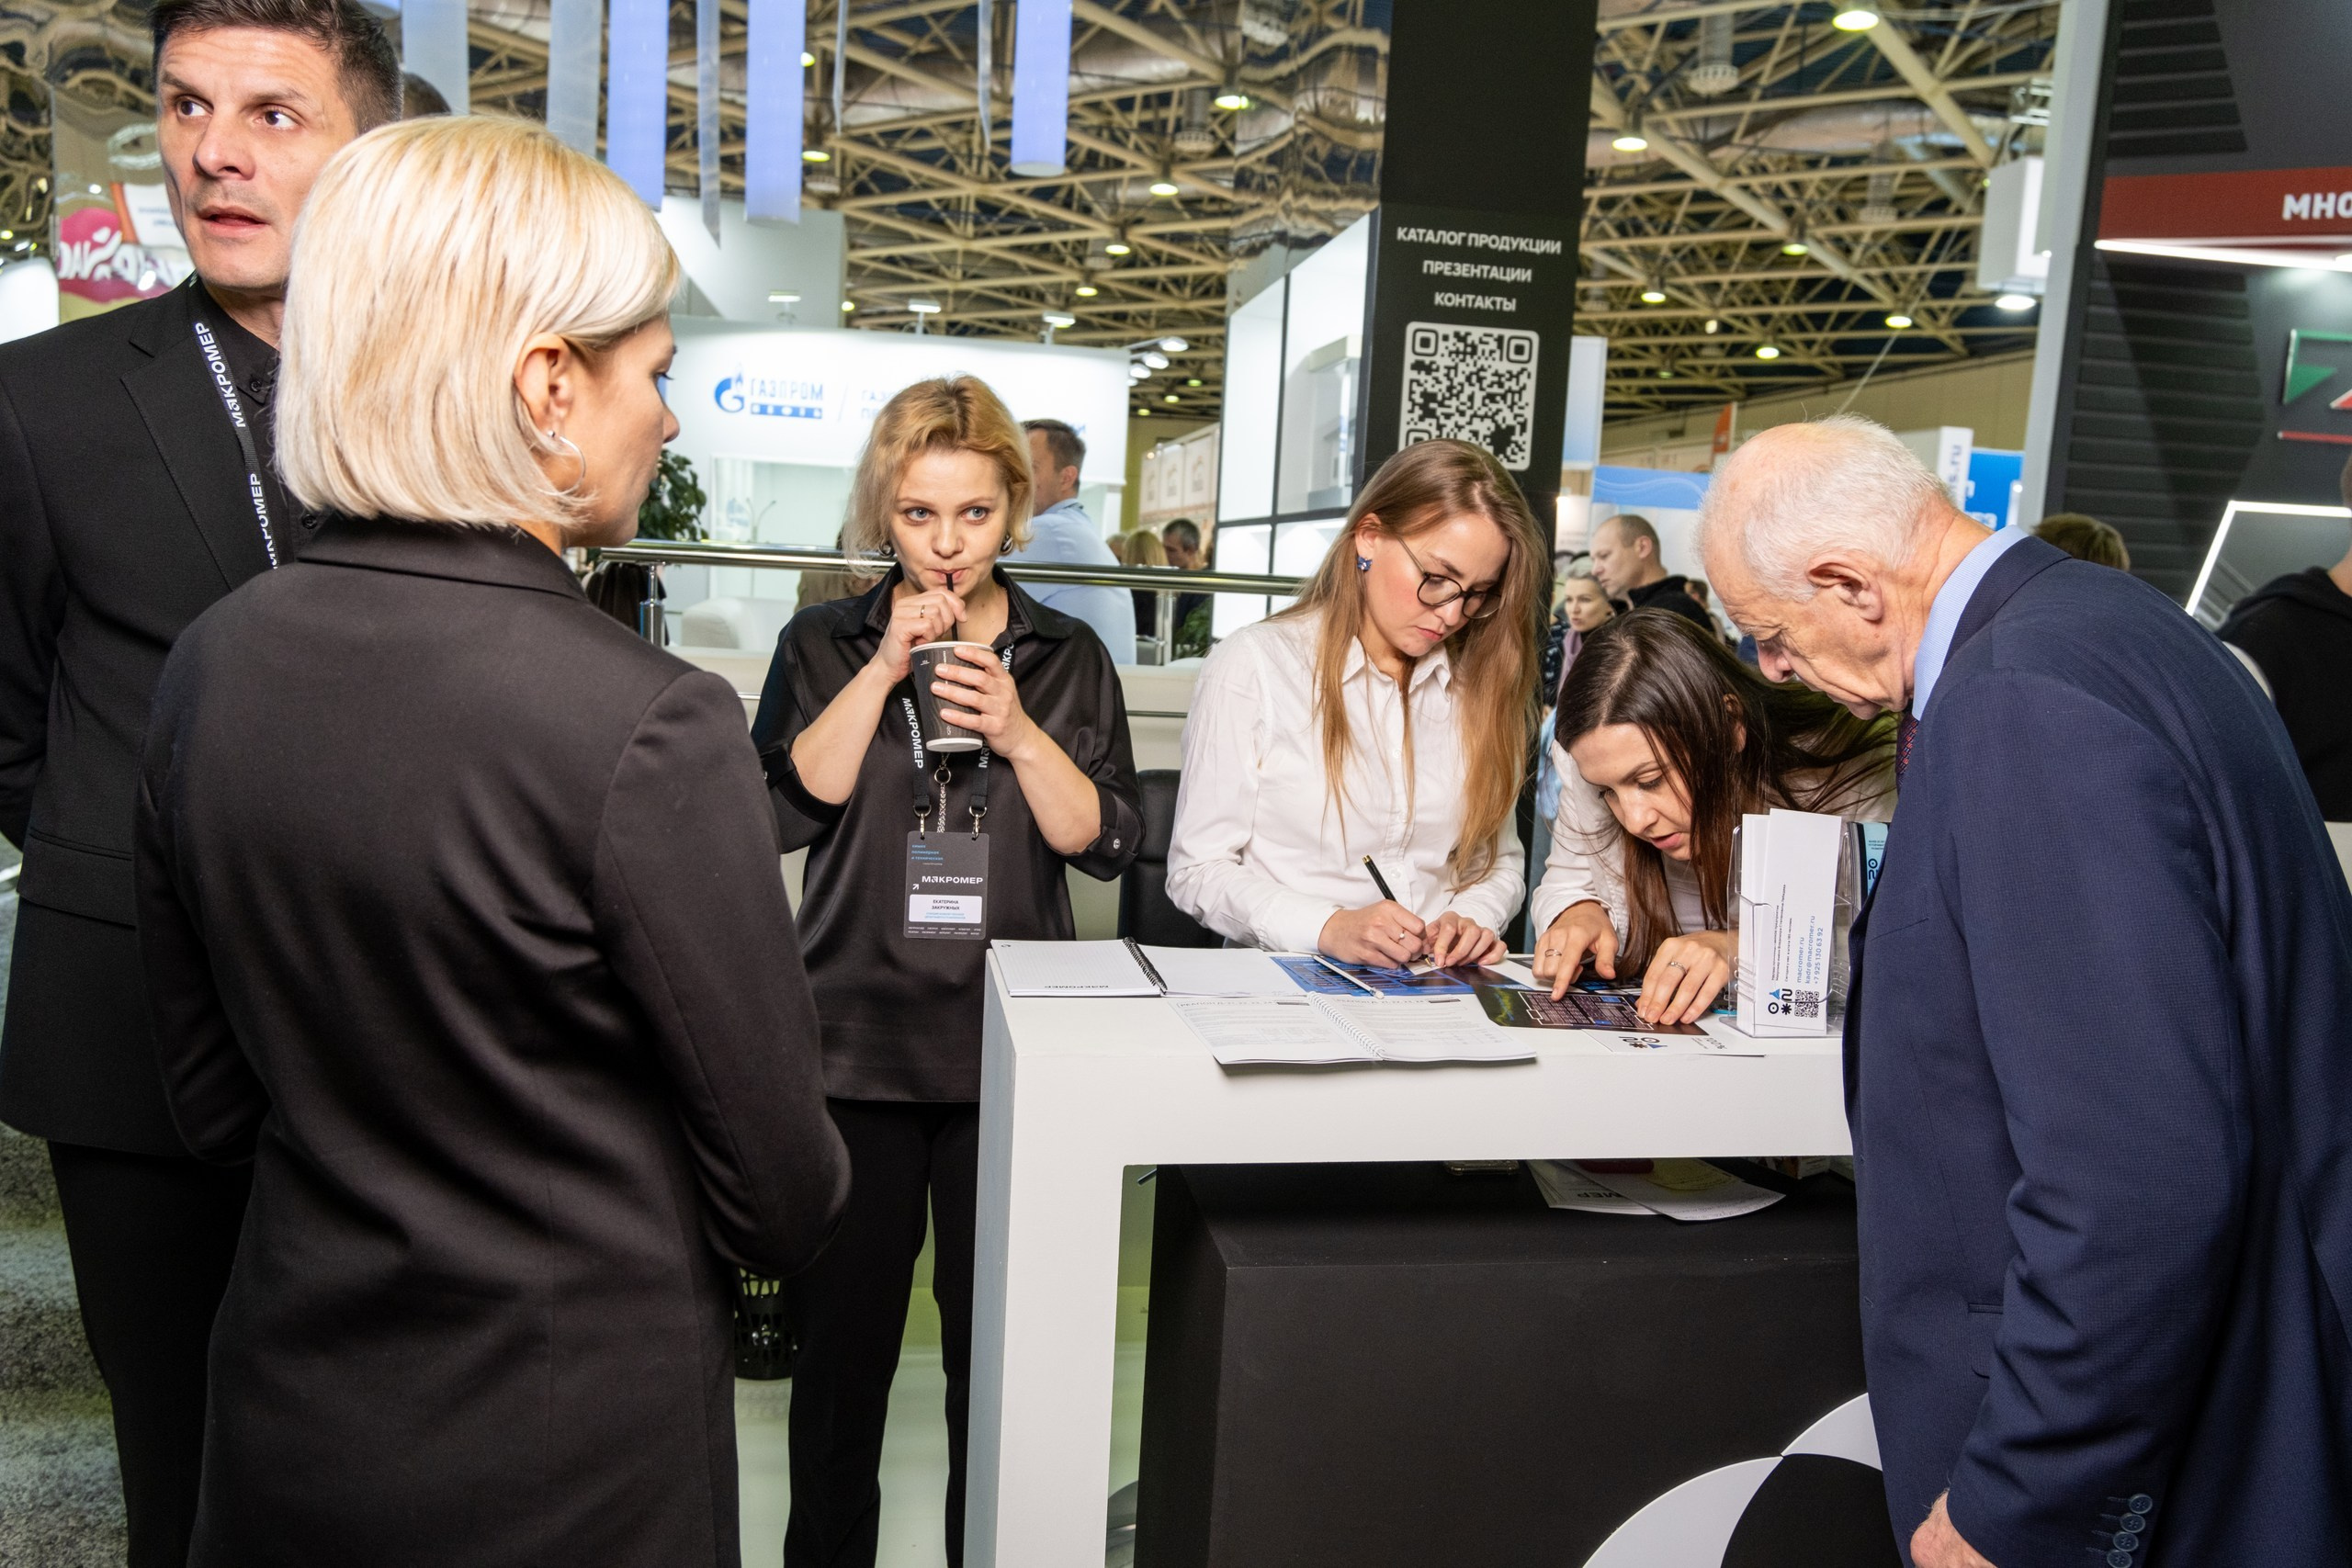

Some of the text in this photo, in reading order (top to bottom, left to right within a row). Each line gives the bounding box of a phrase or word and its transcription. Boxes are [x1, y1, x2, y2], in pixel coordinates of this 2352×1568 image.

[1396, 227, 1562, 254] КАТАЛОГ ПРОДУКЦИИ
[1423, 260, 1532, 283] ПРЕЗЕНТАЦИИ
[1434, 292, 1517, 312] КОНТАКТЫ
[751, 378, 823, 400] ГАЗПРОМ
[1816, 937, 1822, 946] 63
[1817, 927, 1823, 936] 92
[1805, 916, 1815, 984] kadr@macromer.ru
